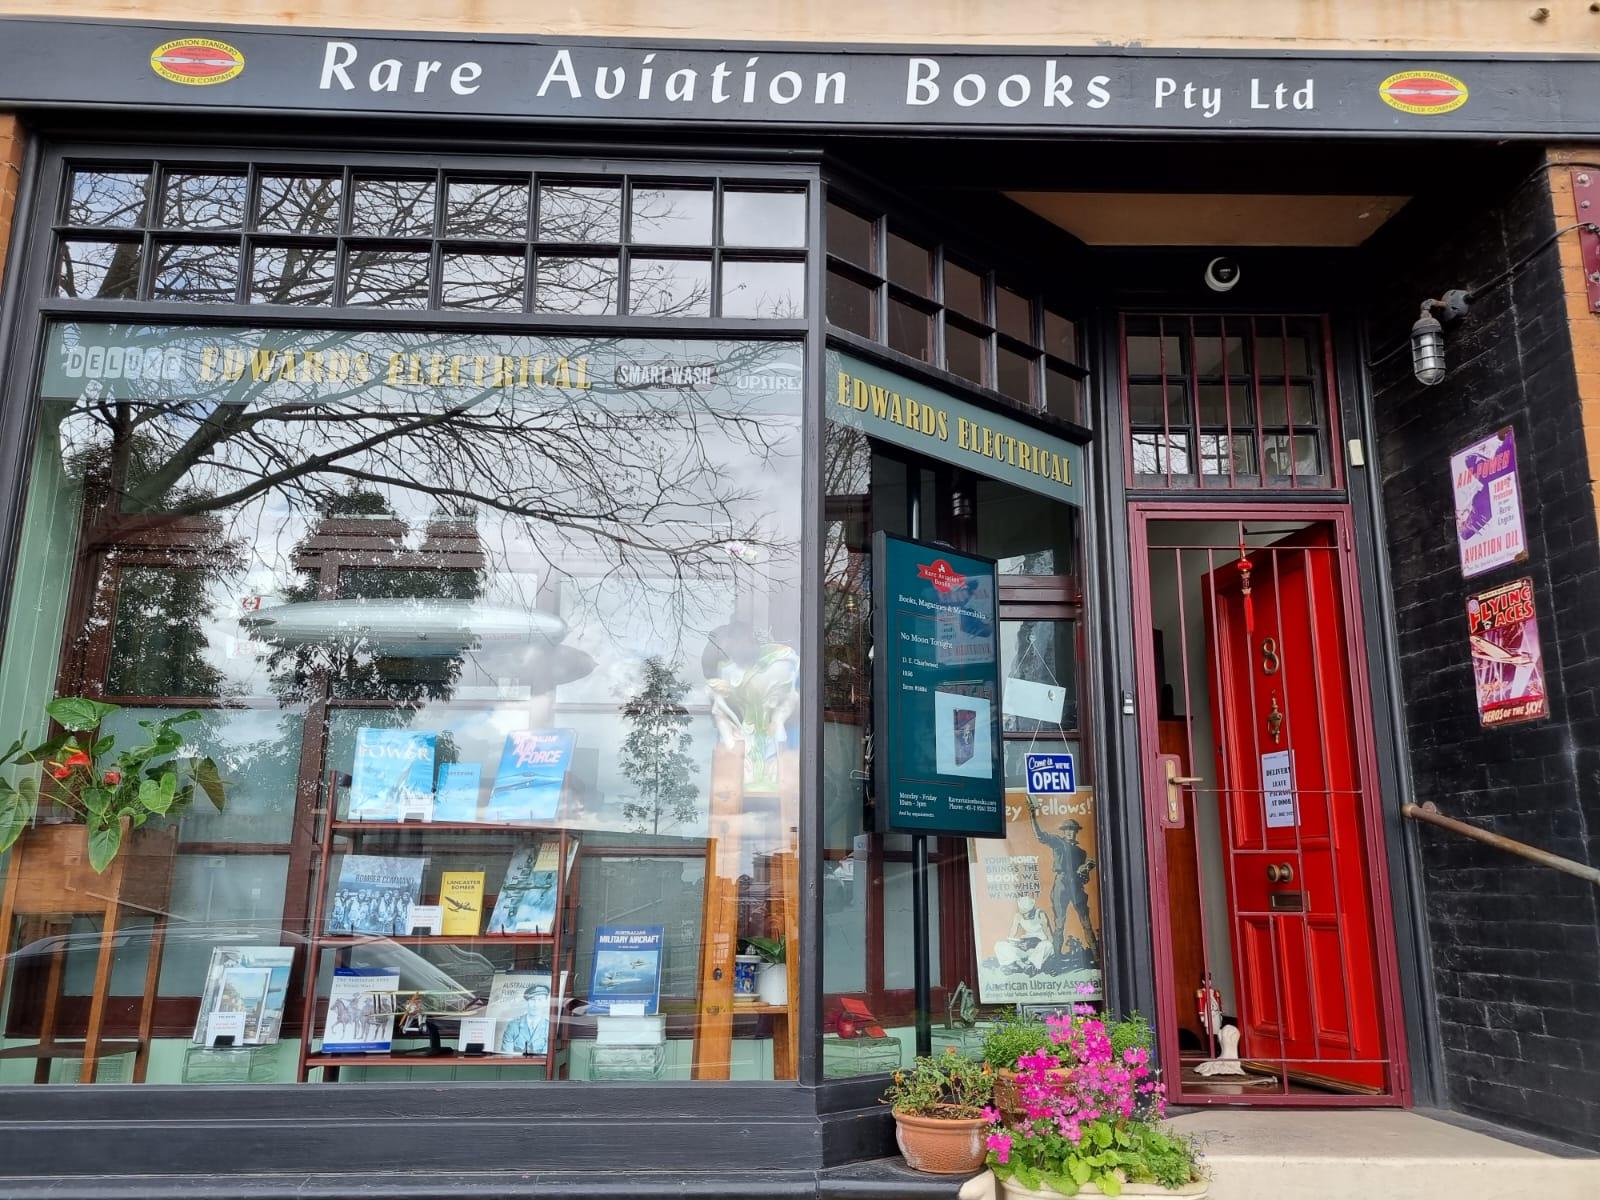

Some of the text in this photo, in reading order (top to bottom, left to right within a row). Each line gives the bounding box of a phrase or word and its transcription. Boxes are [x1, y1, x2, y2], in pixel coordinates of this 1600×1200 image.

[160, 40, 238, 56] HAMILTON STANDARD
[159, 67, 235, 84] PROPELLER COMPANY
[319, 41, 1314, 118] Rare Aviation Books Pty Ltd
[199, 346, 593, 390] EDWARDS ELECTRICAL
[837, 370, 1073, 488] EDWARDS ELECTRICAL
[1456, 450, 1511, 489] AIR POWER
[1464, 535, 1502, 564] AVIATION
[1505, 529, 1519, 550] OIL
[1470, 585, 1533, 634] FLYING
[1494, 600, 1534, 628] ACES
[900, 631, 910, 641] No
[911, 634, 929, 645] Moon
[931, 637, 953, 650] Tonight
[1263, 637, 1279, 675] 8
[1512, 705, 1525, 716] THE
[1028, 756, 1047, 770] Come
[1032, 770, 1071, 790] OPEN
[899, 792, 919, 801] Monday
[923, 794, 938, 803] Friday
[1005, 803, 1022, 822] ey
[1009, 855, 1039, 865] MONEY
[986, 864, 1040, 874] BRINGS THE
[355, 874, 381, 882] BOMBER
[986, 873, 1039, 882] BOOK WE
[988, 881, 1040, 892] NEED WHEN
[1007, 891, 1029, 899] WANT
[1031, 890, 1041, 899] IT
[599, 935, 660, 944] MILITARY AIRCRAFT
[984, 979, 1028, 992] American
[1030, 978, 1062, 994] Library
